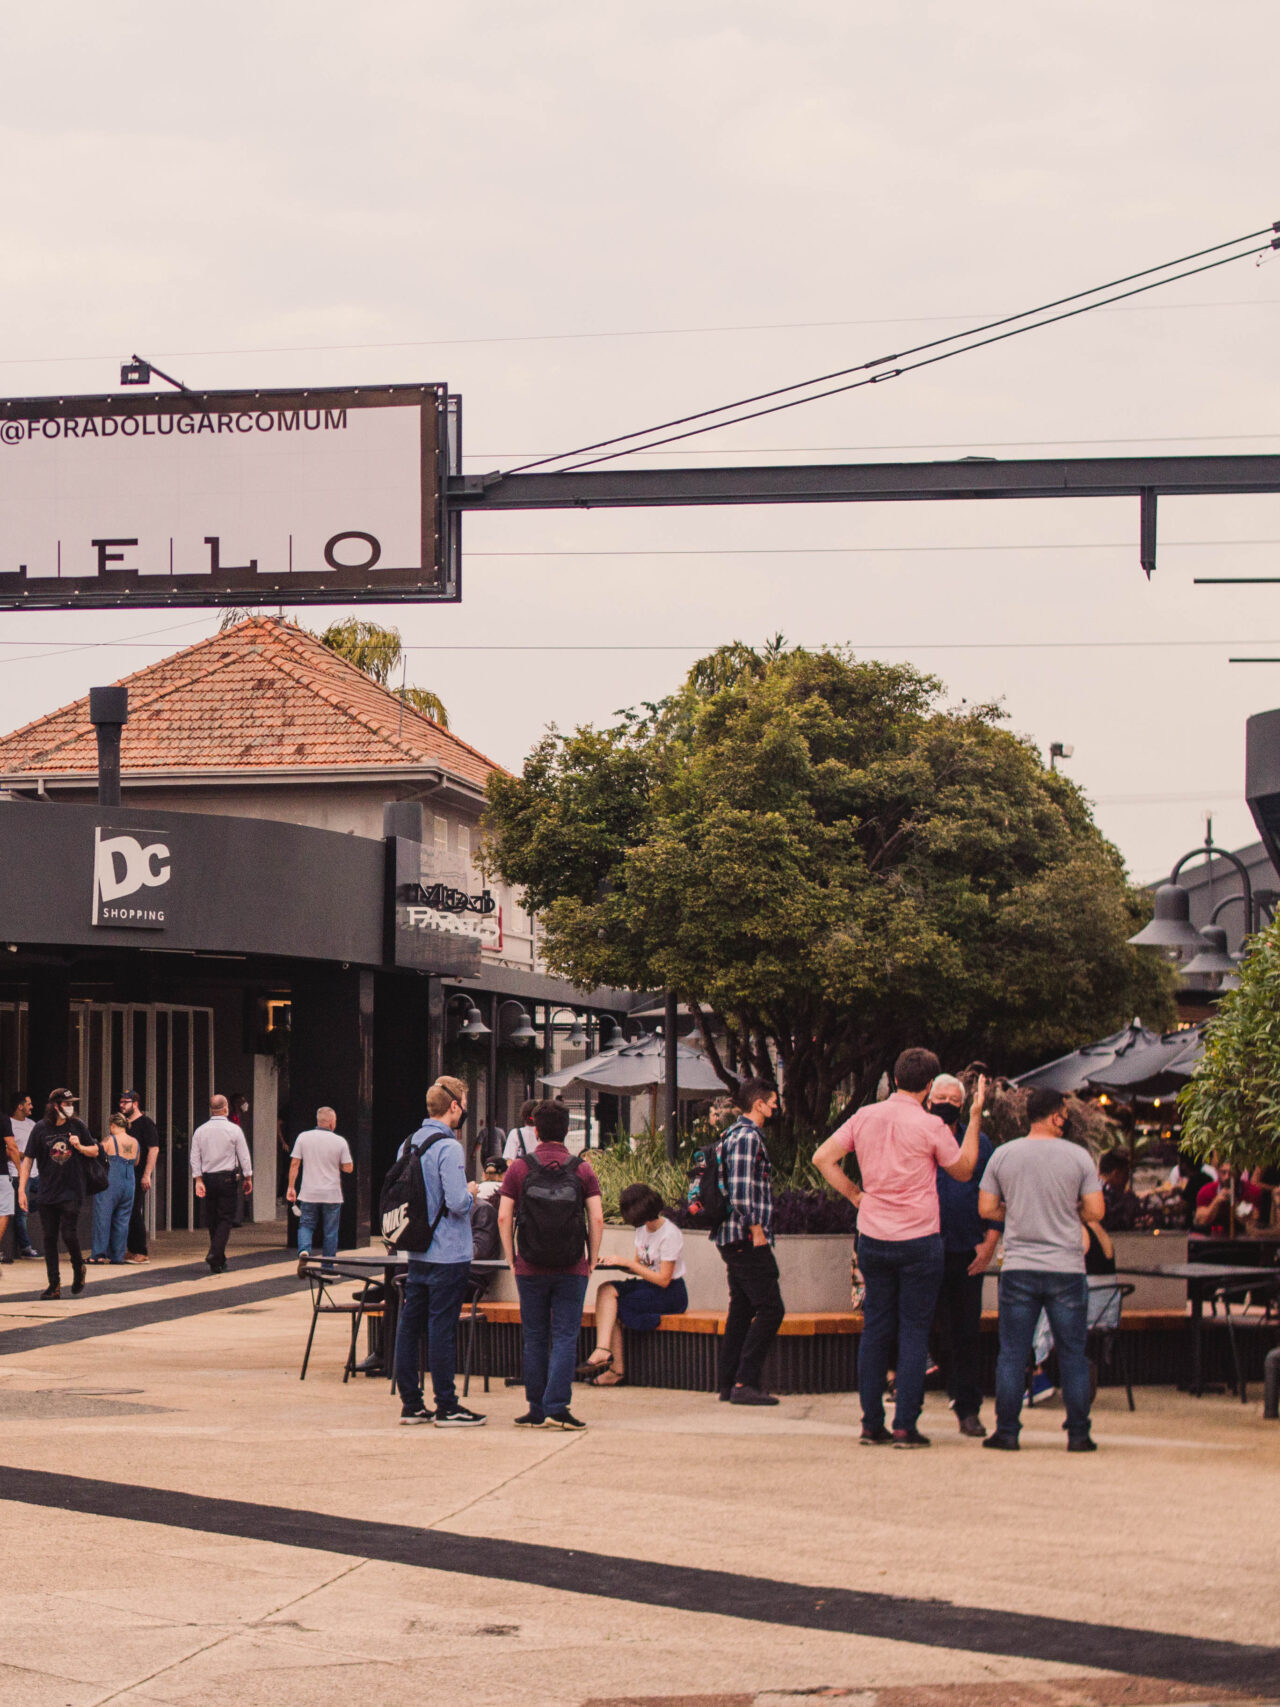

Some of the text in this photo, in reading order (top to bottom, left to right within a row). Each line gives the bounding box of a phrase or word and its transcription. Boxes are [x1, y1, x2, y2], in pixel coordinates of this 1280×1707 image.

[0, 408, 348, 446] @FORADOLUGARCOMUM
[103, 907, 165, 921] SHOPPING
[382, 1202, 409, 1235] NIKE
